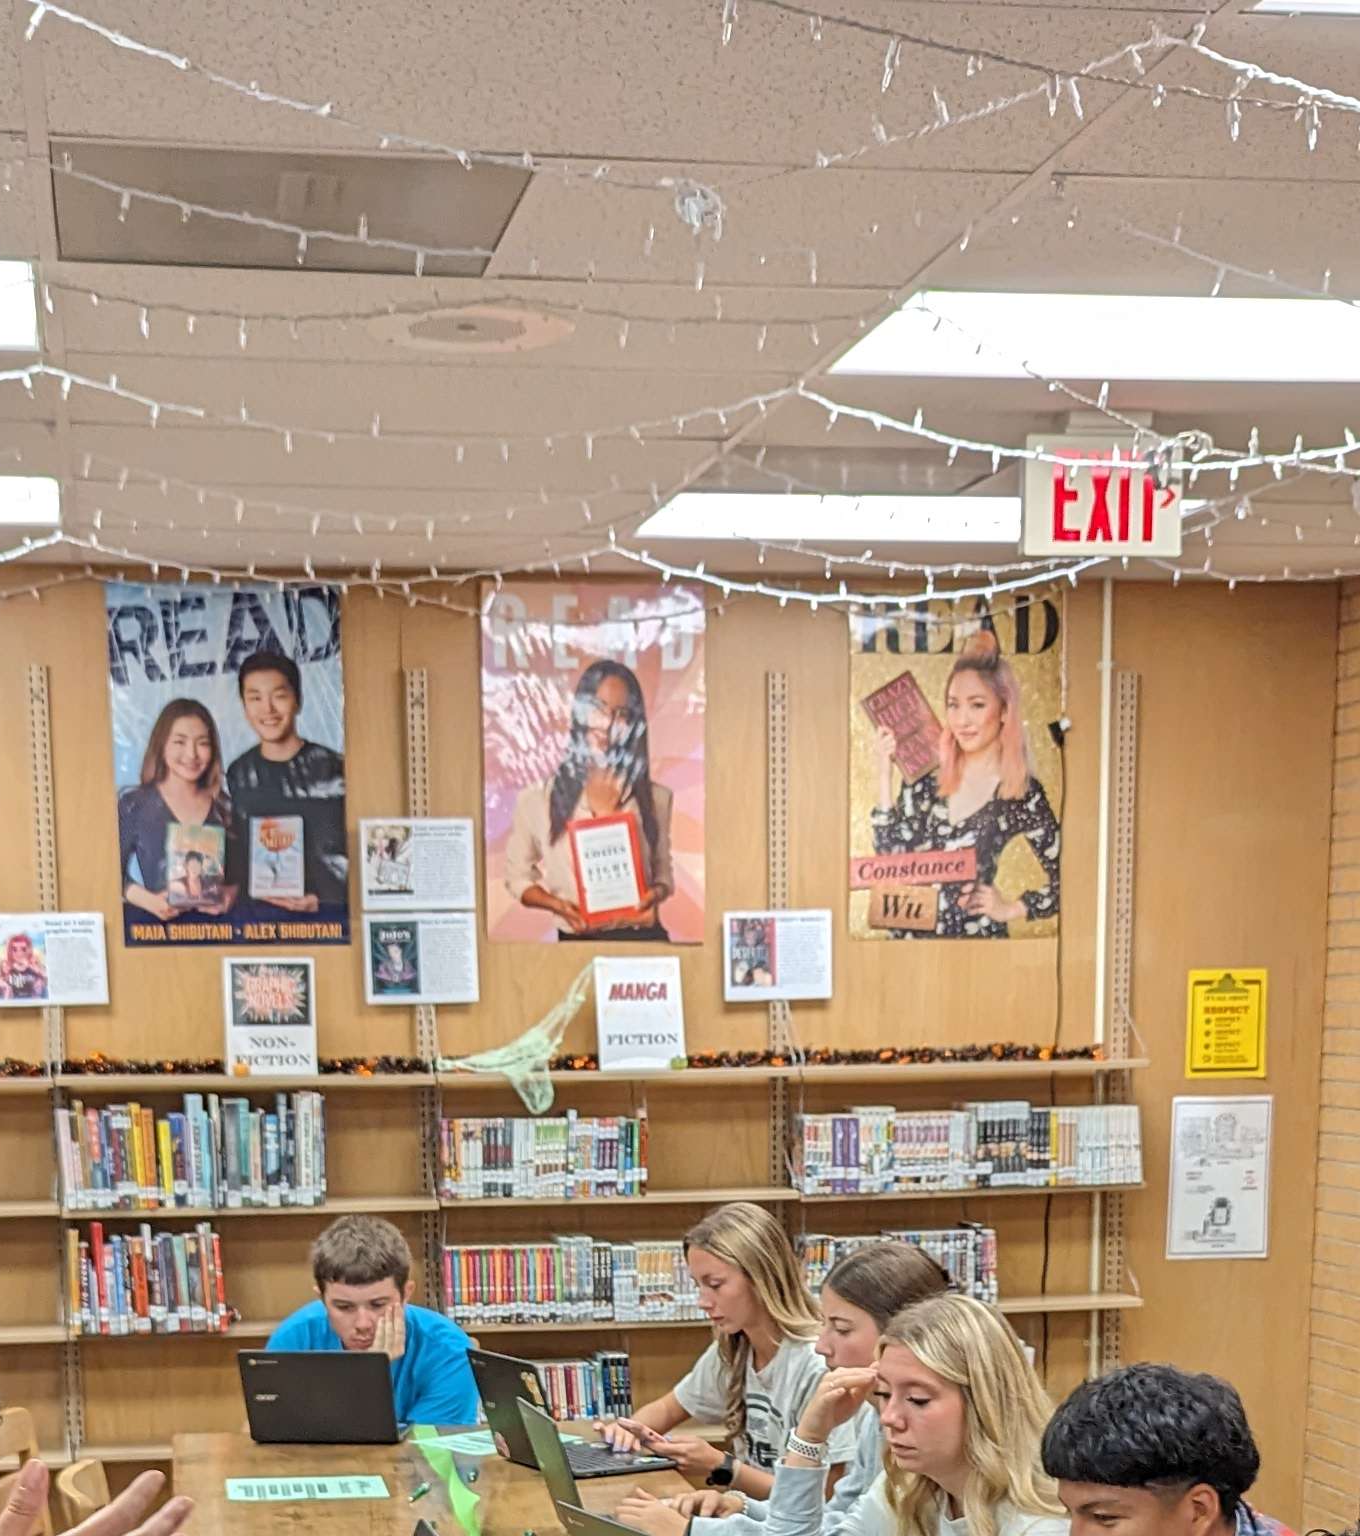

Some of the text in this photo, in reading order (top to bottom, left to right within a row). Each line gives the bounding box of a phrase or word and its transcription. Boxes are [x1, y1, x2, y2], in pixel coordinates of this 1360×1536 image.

[1053, 448, 1160, 542] EXIT
[107, 587, 342, 685] READ
[858, 860, 965, 880] Constance
[882, 894, 923, 919] Wu
[132, 923, 342, 940] MAIA SHIBUTANI ALEX SHIBUTANI
[608, 982, 668, 1001] MANGA
[249, 1036, 297, 1049] NON-
[606, 1033, 678, 1045] FICTION
[235, 1055, 311, 1066] FICTION
